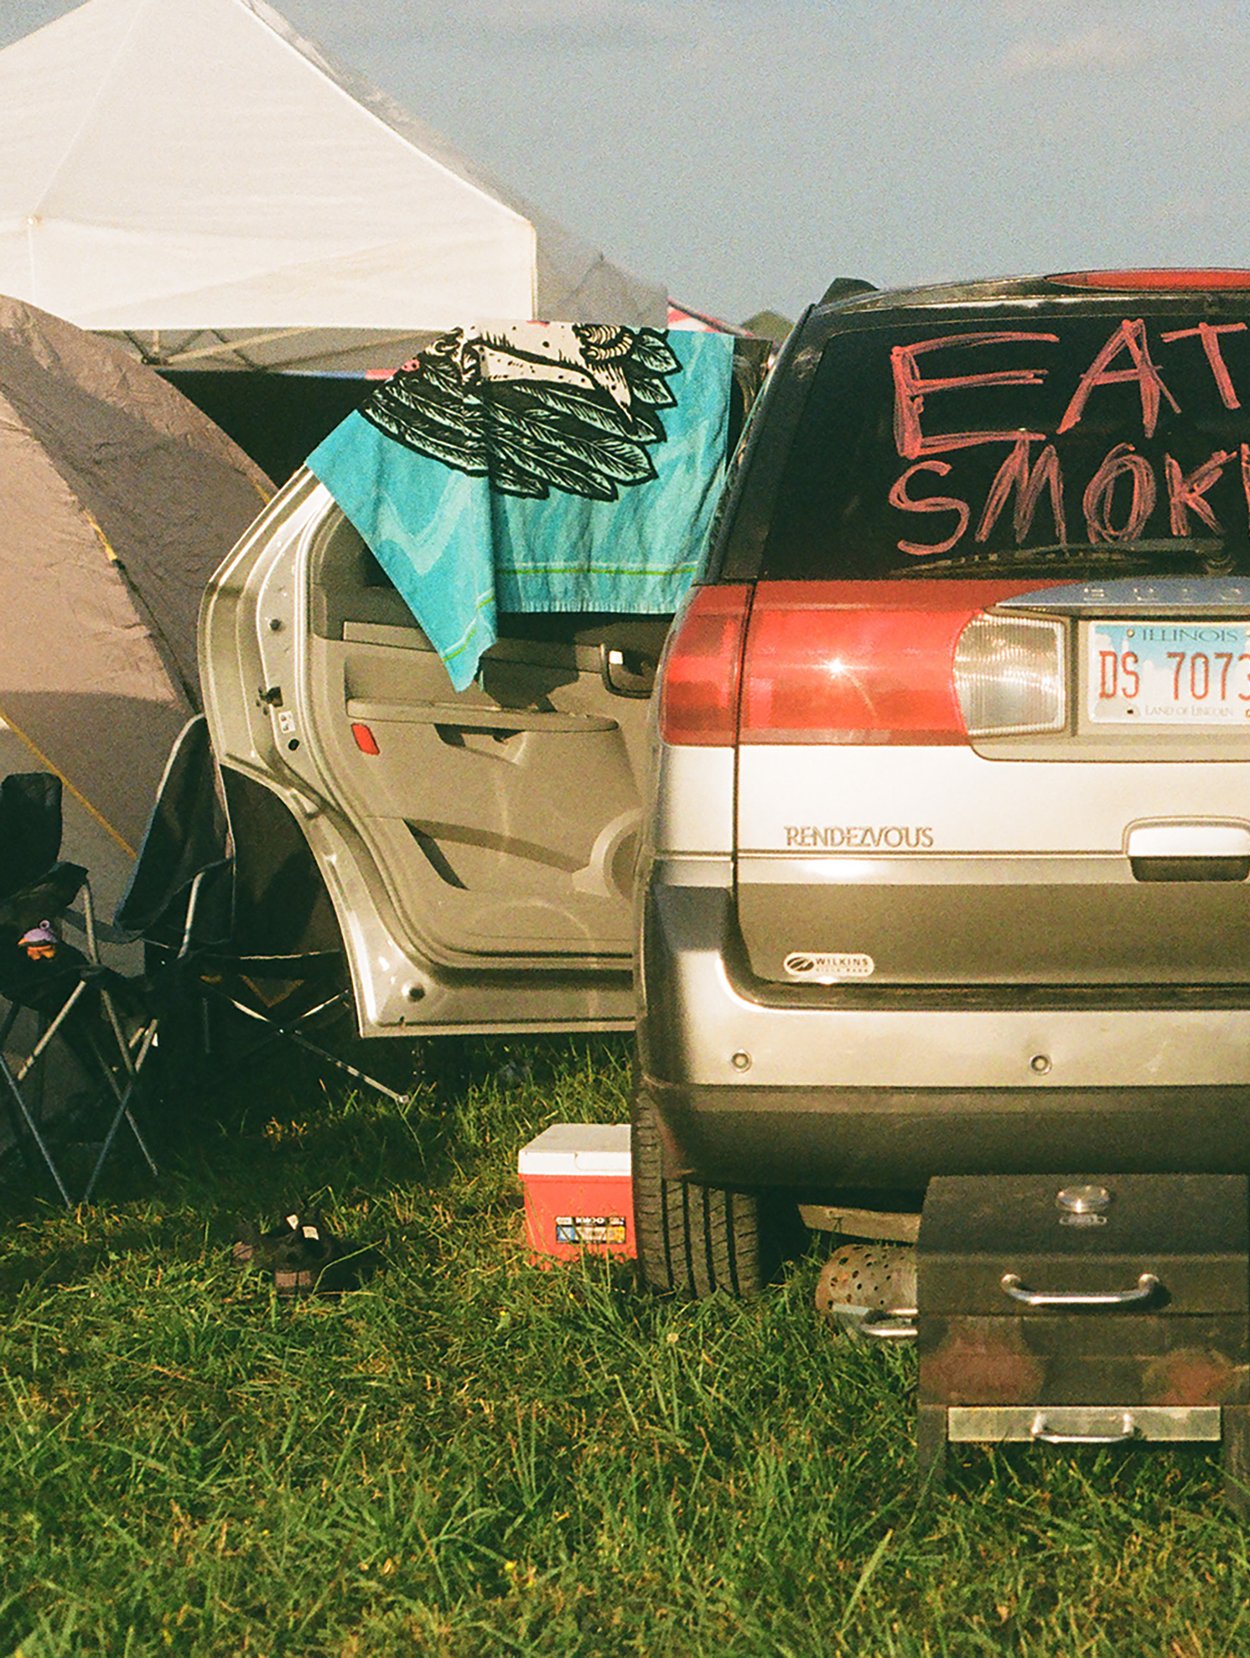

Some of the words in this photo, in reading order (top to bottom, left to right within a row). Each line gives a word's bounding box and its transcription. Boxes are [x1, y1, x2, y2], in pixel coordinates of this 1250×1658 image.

[890, 318, 1248, 460] EAT
[1140, 627, 1240, 643] ILLINOIS
[1098, 650, 1140, 699] DS
[783, 825, 934, 848] RENDEZVOUS
[815, 957, 869, 967] WILKINS
